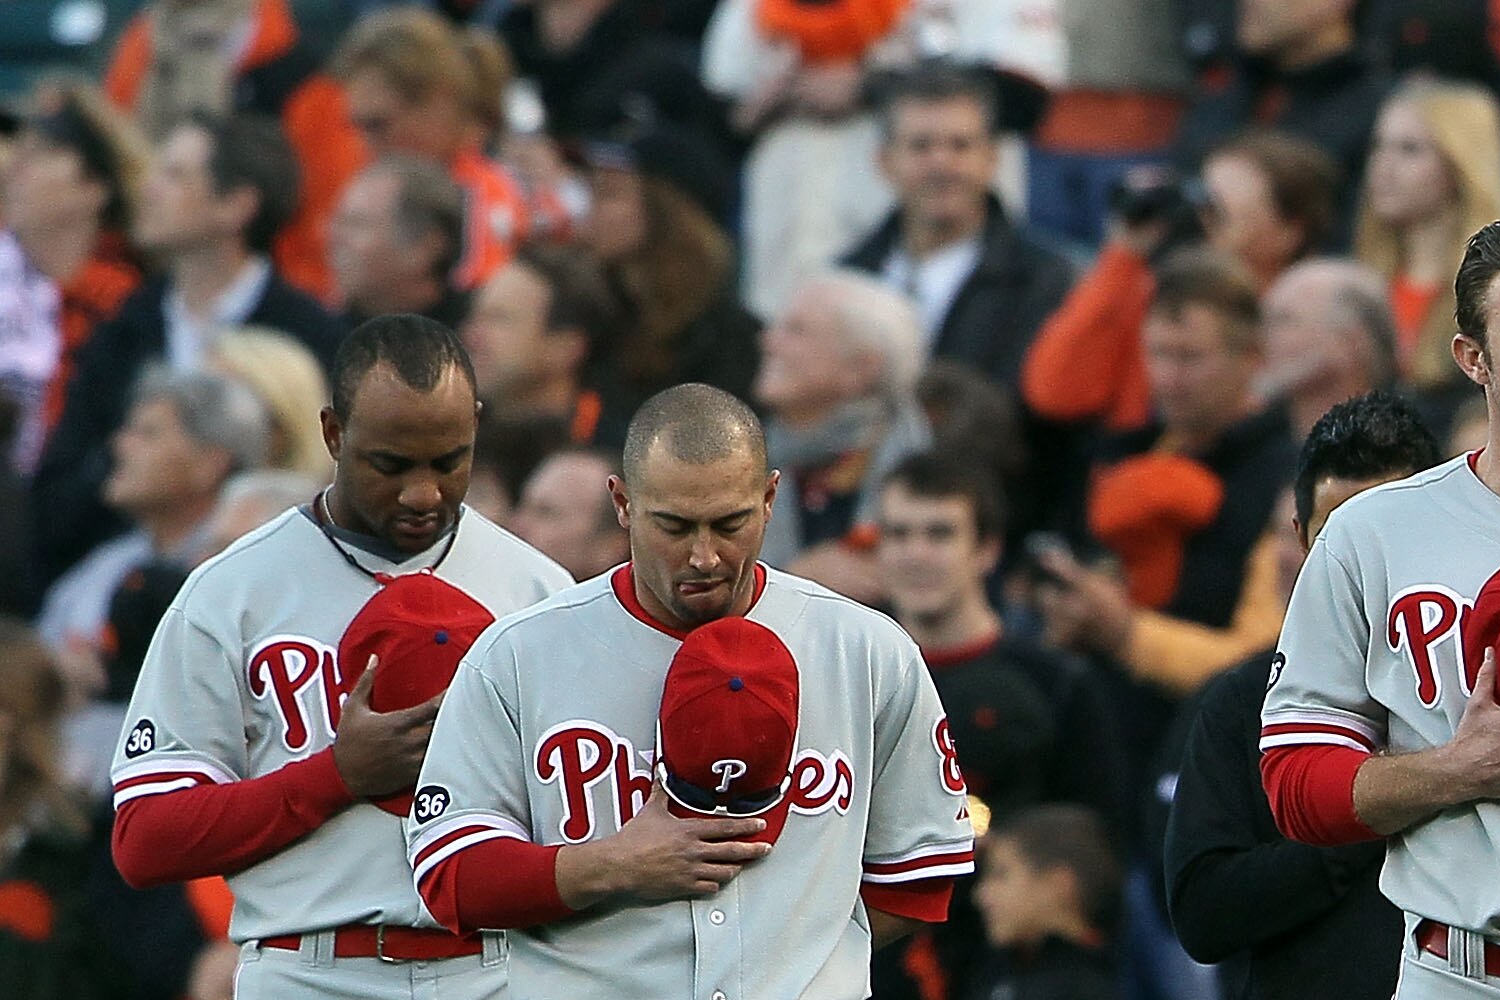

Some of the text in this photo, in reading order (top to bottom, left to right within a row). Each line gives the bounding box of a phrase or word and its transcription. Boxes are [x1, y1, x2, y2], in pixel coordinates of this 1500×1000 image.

[127, 726, 153, 753] 36
[711, 759, 747, 793] P
[417, 793, 446, 817] 36
